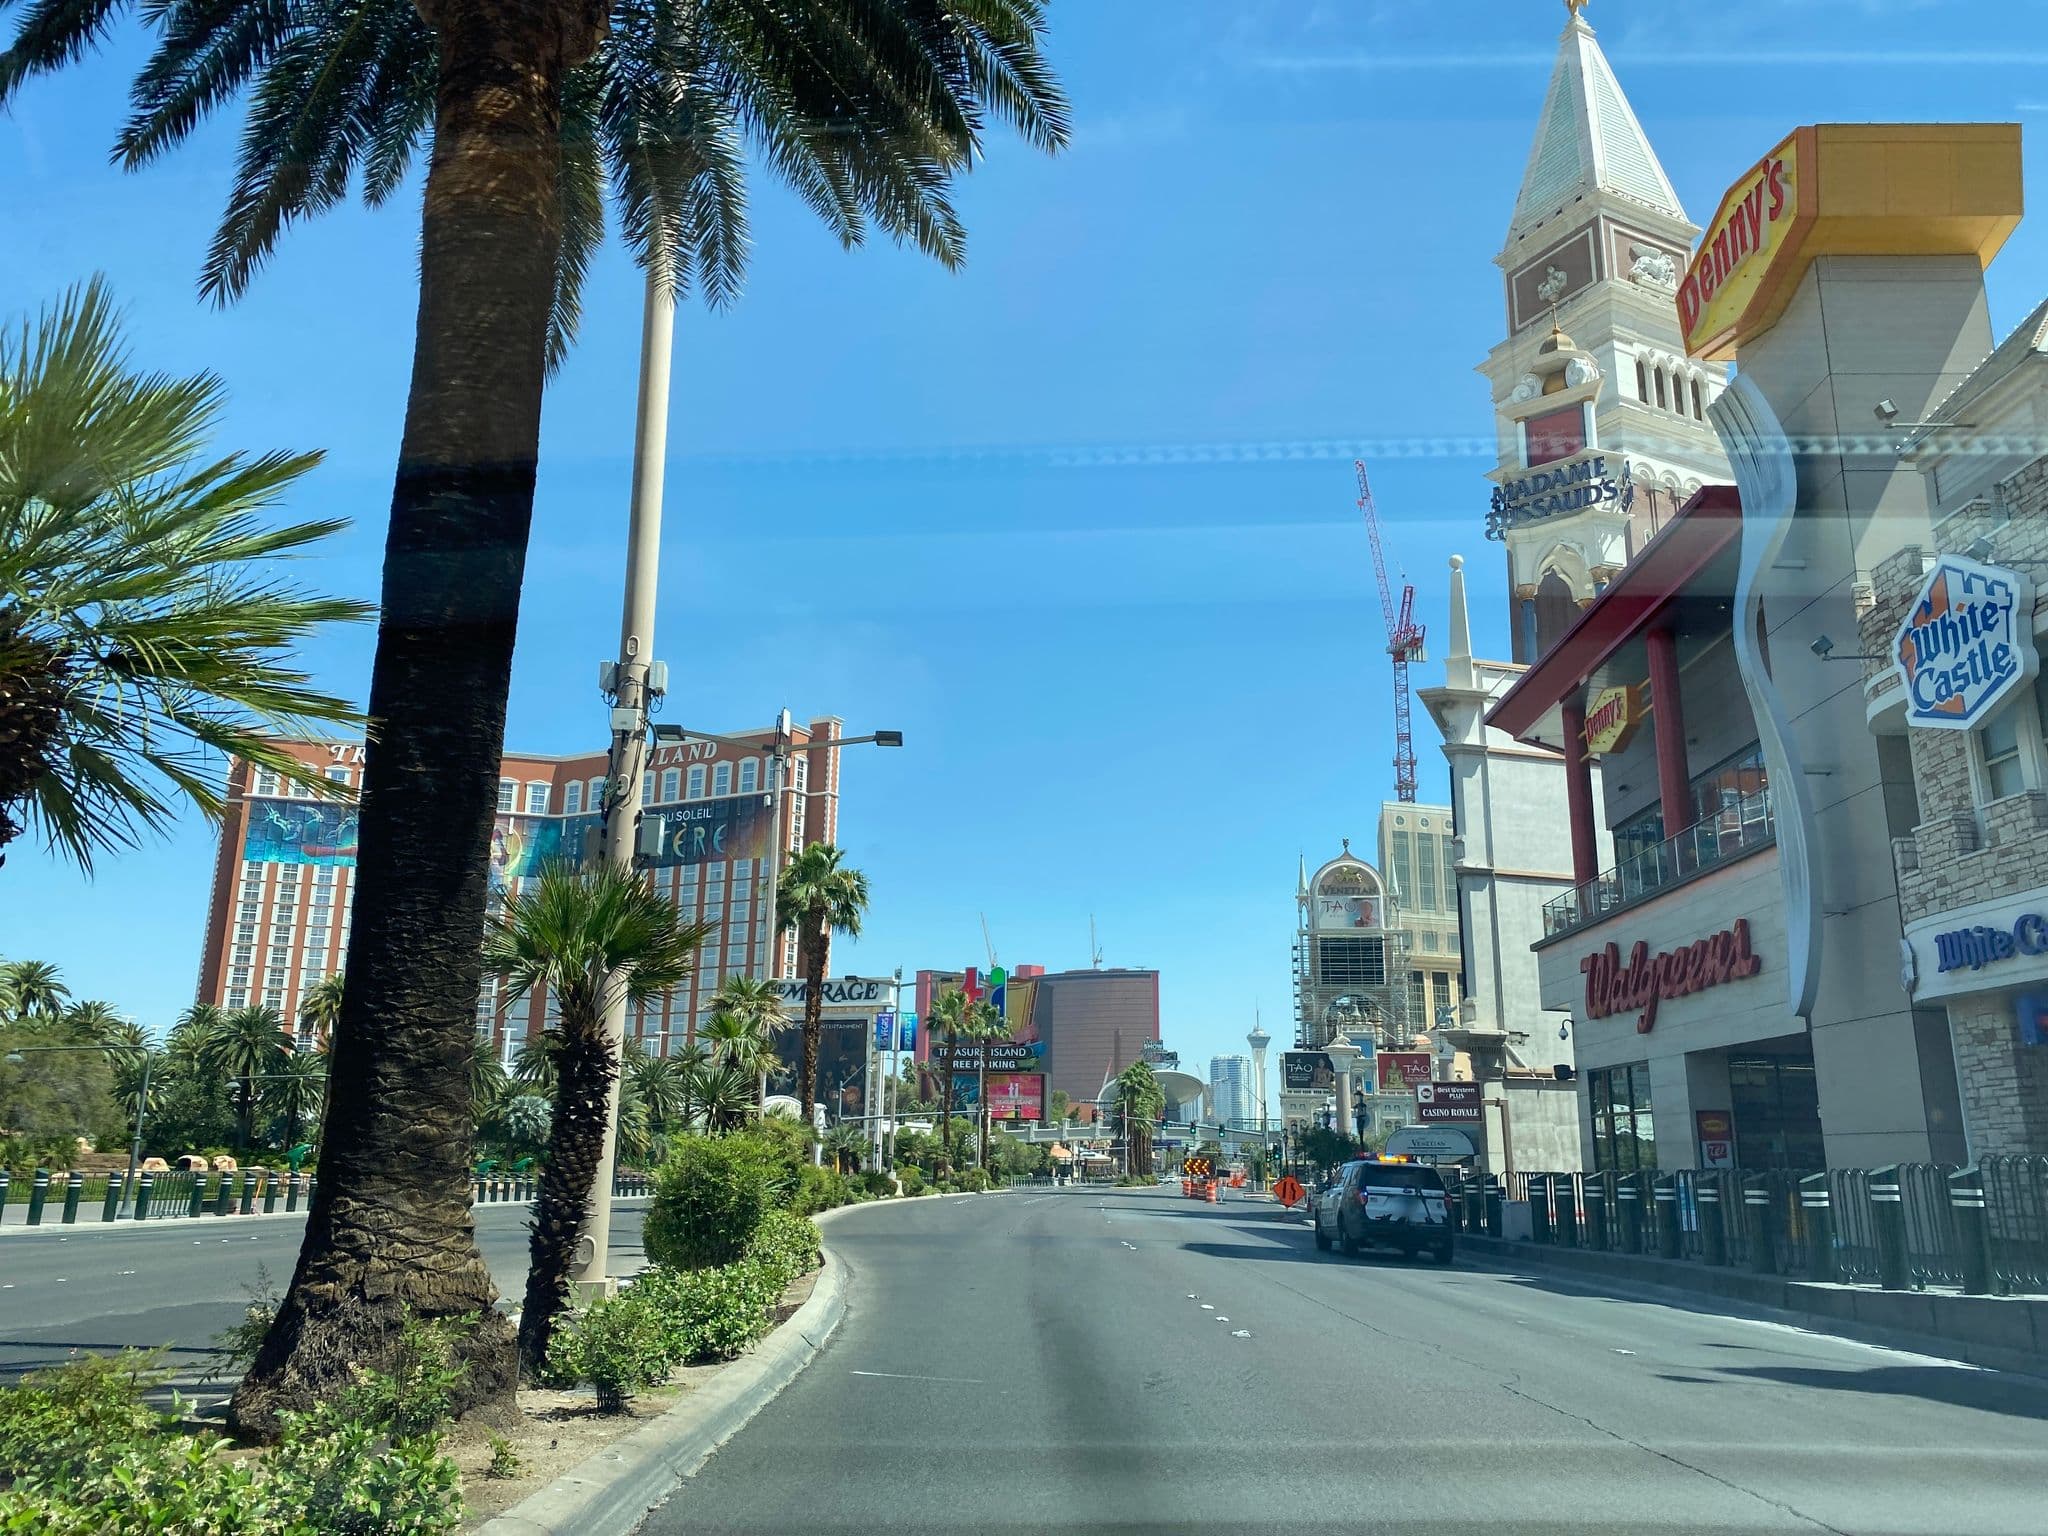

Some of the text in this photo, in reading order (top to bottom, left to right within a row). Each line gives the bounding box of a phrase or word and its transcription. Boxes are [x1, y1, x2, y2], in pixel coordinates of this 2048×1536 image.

[1681, 158, 1784, 338] Denny's
[1492, 456, 1608, 503] MADAME
[1910, 601, 1999, 671] White
[1912, 639, 2010, 709] Castle
[1586, 693, 1622, 745] Denny's
[676, 807, 712, 821] SOLEIL
[1321, 900, 1357, 912] TAO
[1935, 926, 2016, 973] White
[1581, 918, 1760, 1034] Walgreens
[783, 983, 879, 1003] MRAGE
[990, 1047, 1026, 1056] ISLAND
[952, 1060, 970, 1069] REE
[1287, 1063, 1313, 1073] TAO
[1402, 1064, 1430, 1074] TAO
[1422, 1108, 1480, 1117] CASINO ROYALE
